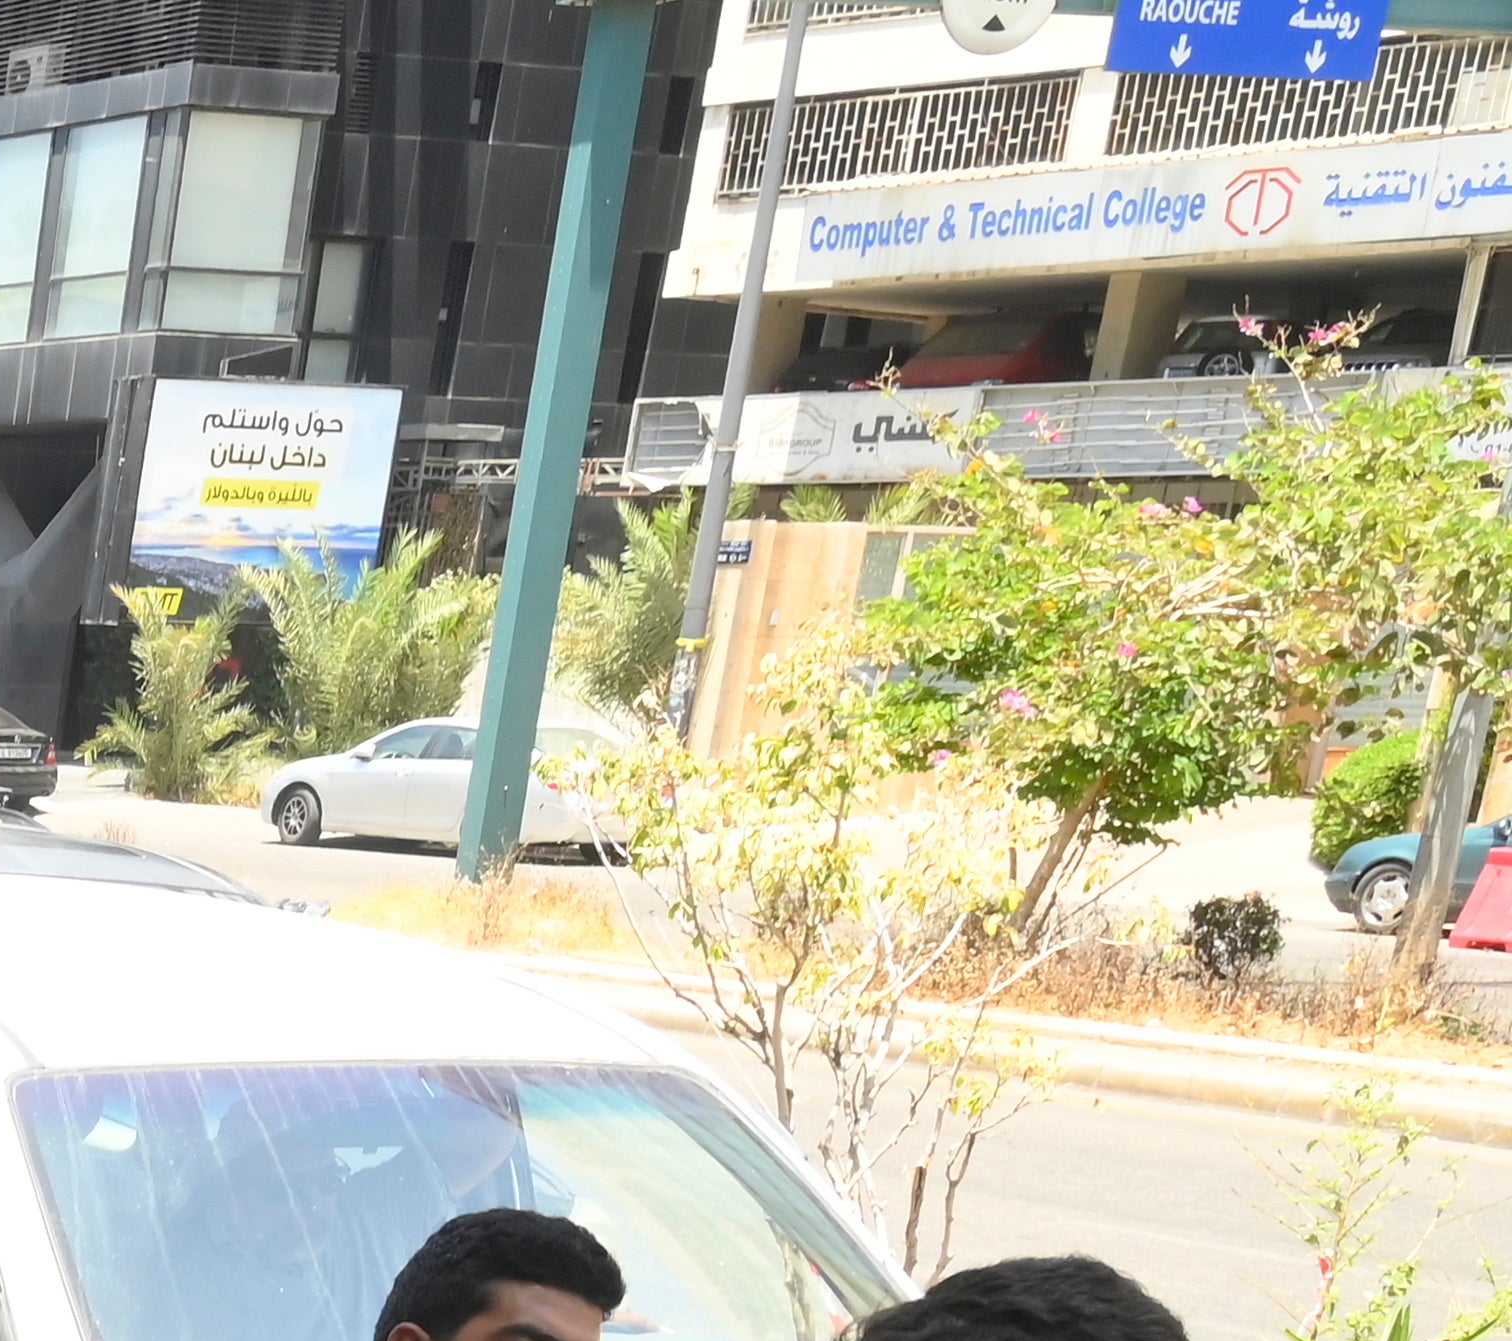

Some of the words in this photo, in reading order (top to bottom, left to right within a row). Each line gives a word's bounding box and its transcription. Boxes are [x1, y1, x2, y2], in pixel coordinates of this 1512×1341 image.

[1140, 0, 1242, 28] RAOUCHE
[808, 206, 930, 258] Computer
[937, 203, 956, 239] &
[968, 189, 1095, 241] Technical
[1102, 183, 1208, 229] College
[202, 408, 290, 436] واستلم
[210, 442, 266, 470] لبنان
[270, 444, 327, 471] داخل
[204, 483, 265, 504] وبالدولار
